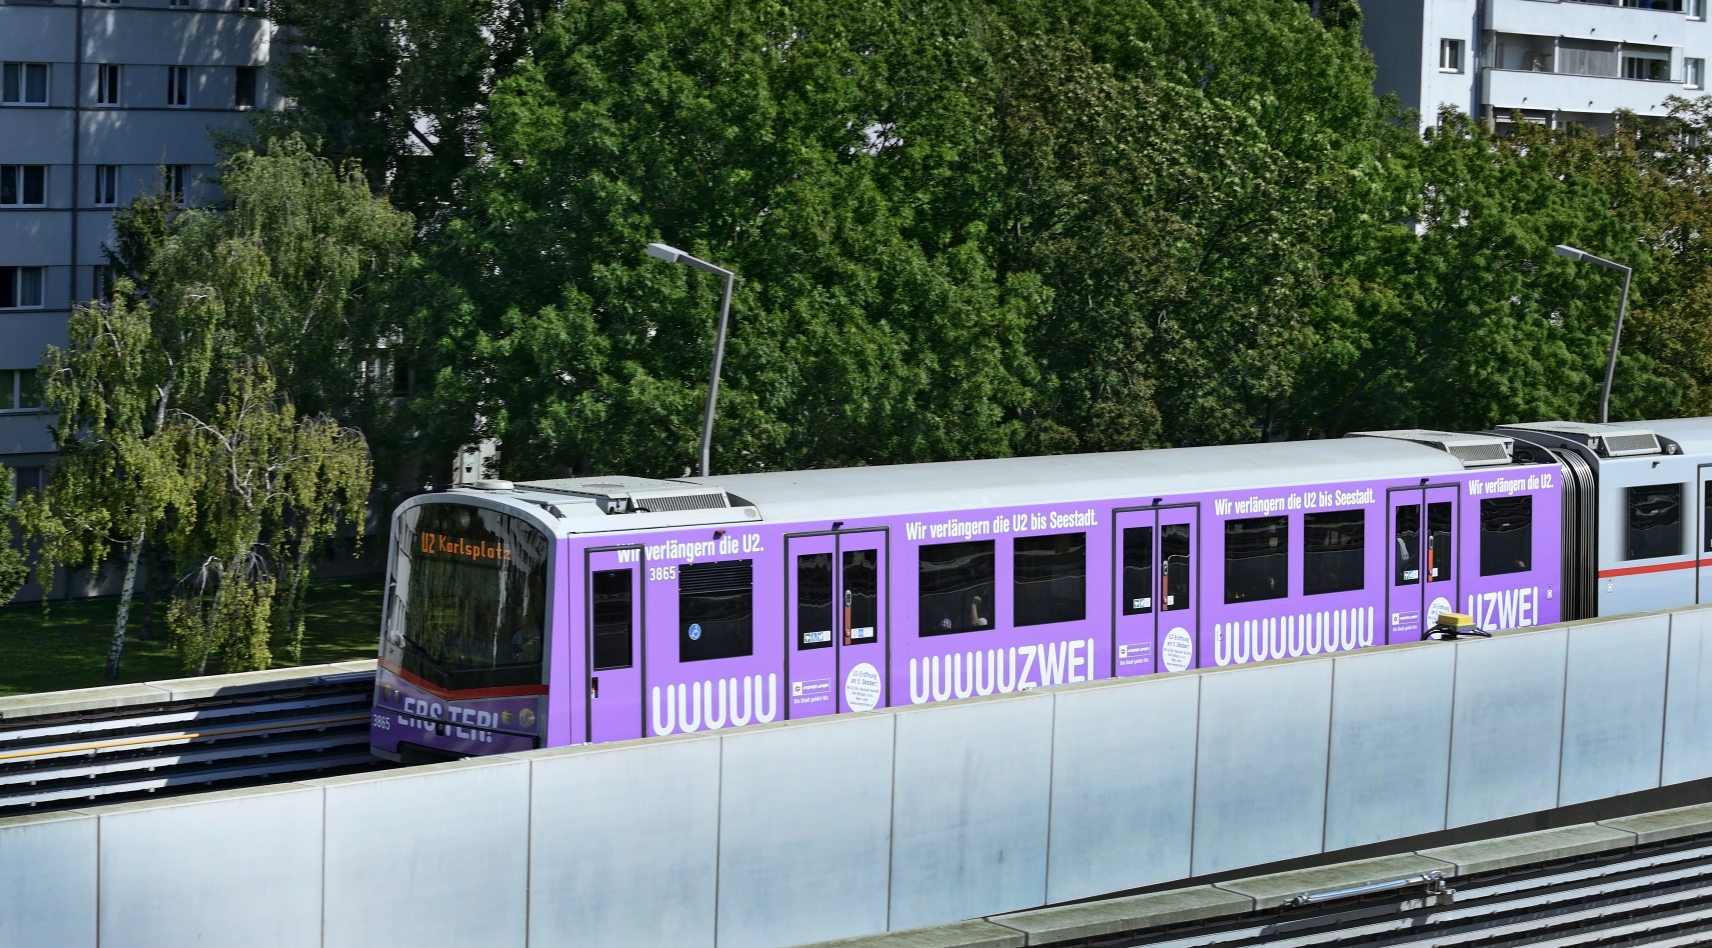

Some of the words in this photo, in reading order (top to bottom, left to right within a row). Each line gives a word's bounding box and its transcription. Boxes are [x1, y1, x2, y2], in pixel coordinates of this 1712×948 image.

[1469, 479, 1483, 496] Wir
[1485, 477, 1527, 495] verlängern
[1527, 474, 1539, 490] die
[1540, 473, 1554, 489] U2.
[1215, 498, 1232, 516] Wir
[1235, 496, 1285, 516] verlängern
[1287, 493, 1302, 510] die
[1304, 492, 1317, 509] U2
[1319, 490, 1333, 507] bis
[1335, 487, 1376, 506] Seestadt.
[905, 520, 927, 541] Wir
[930, 518, 990, 540] verlängern
[993, 515, 1010, 534] die
[1013, 514, 1028, 532] U2
[1031, 511, 1047, 530] bis
[1050, 508, 1098, 529] Seestadt.
[421, 531, 436, 554] U2
[438, 534, 513, 561] Karlsplatz
[617, 543, 641, 563] Wir
[645, 539, 716, 563] verlängern
[719, 535, 740, 555] die
[742, 533, 765, 553] U2.
[650, 566, 677, 581] 3865
[1214, 605, 1375, 667] UUUUUUUUU
[909, 637, 1095, 705] UUUUUZWEI
[652, 672, 777, 736] UUUUU
[373, 713, 391, 731] 3865
